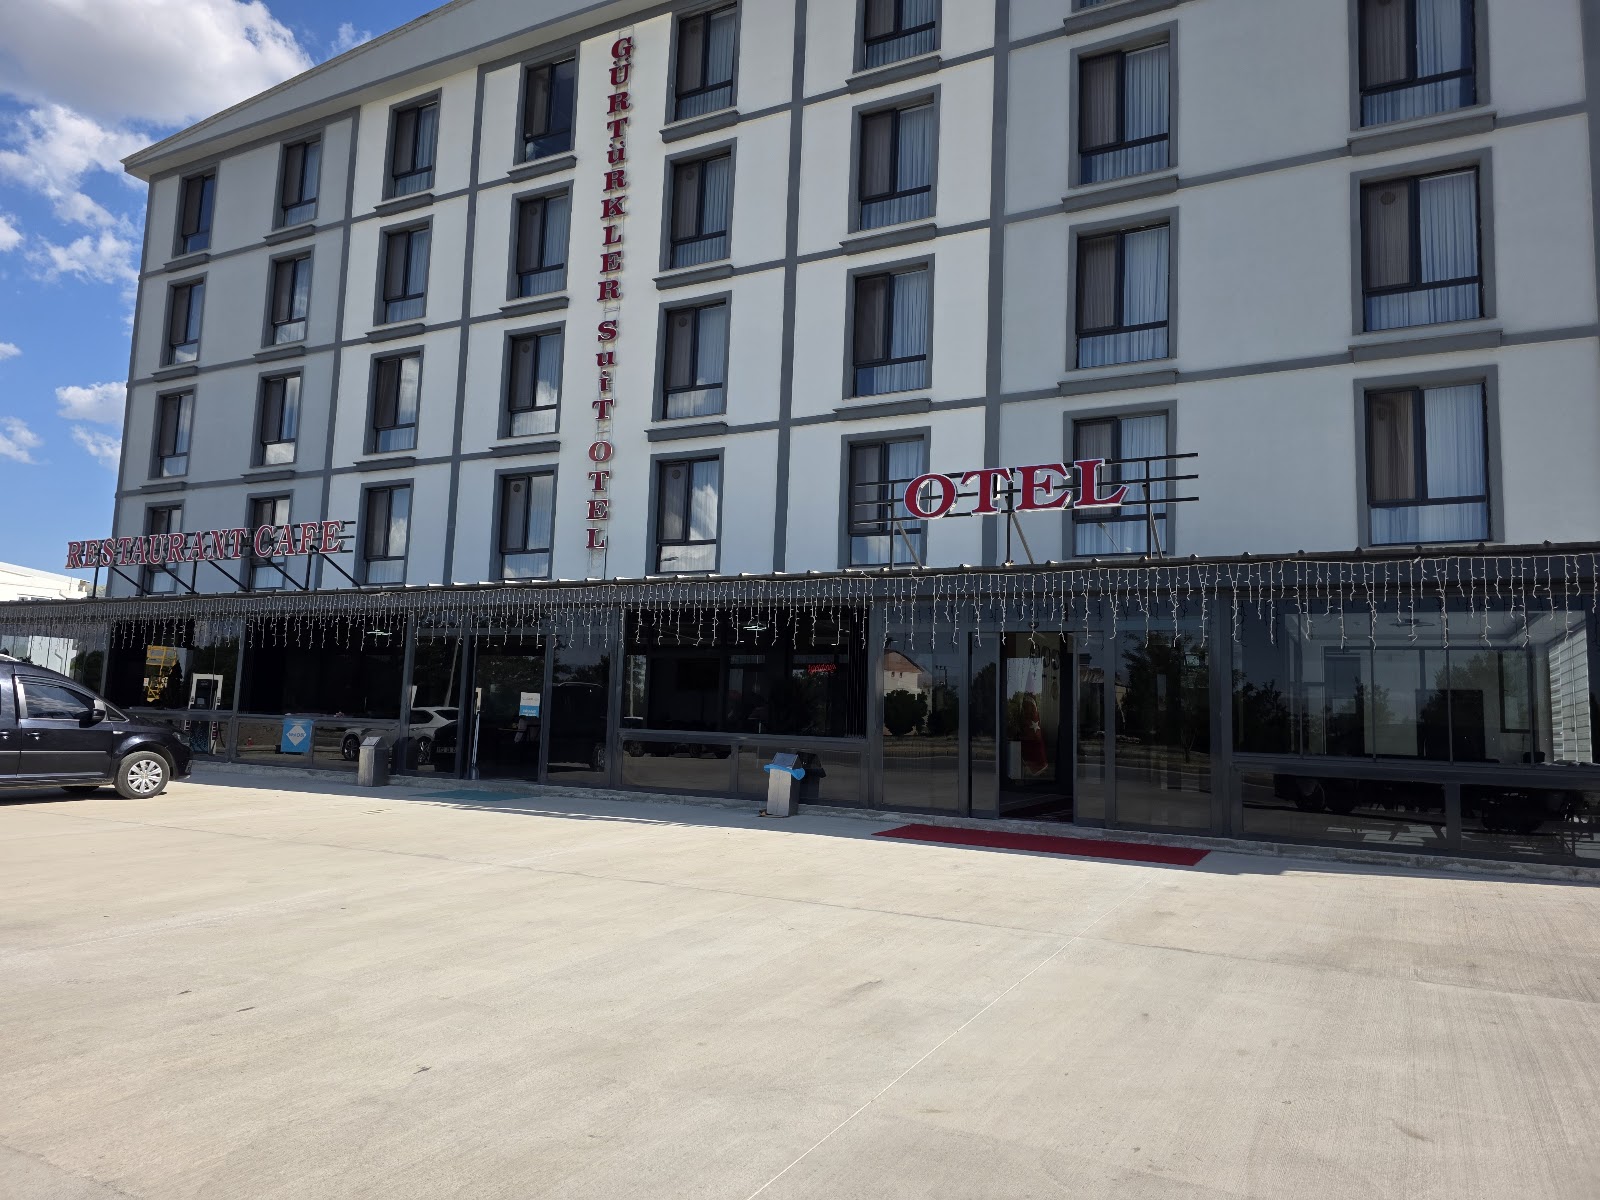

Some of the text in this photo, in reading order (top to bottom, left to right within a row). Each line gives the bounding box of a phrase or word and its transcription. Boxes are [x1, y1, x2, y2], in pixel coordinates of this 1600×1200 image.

[585, 440, 613, 549] OTEL
[903, 458, 1129, 520] OTEL
[65, 520, 346, 569] RESTAURANT CAFE
